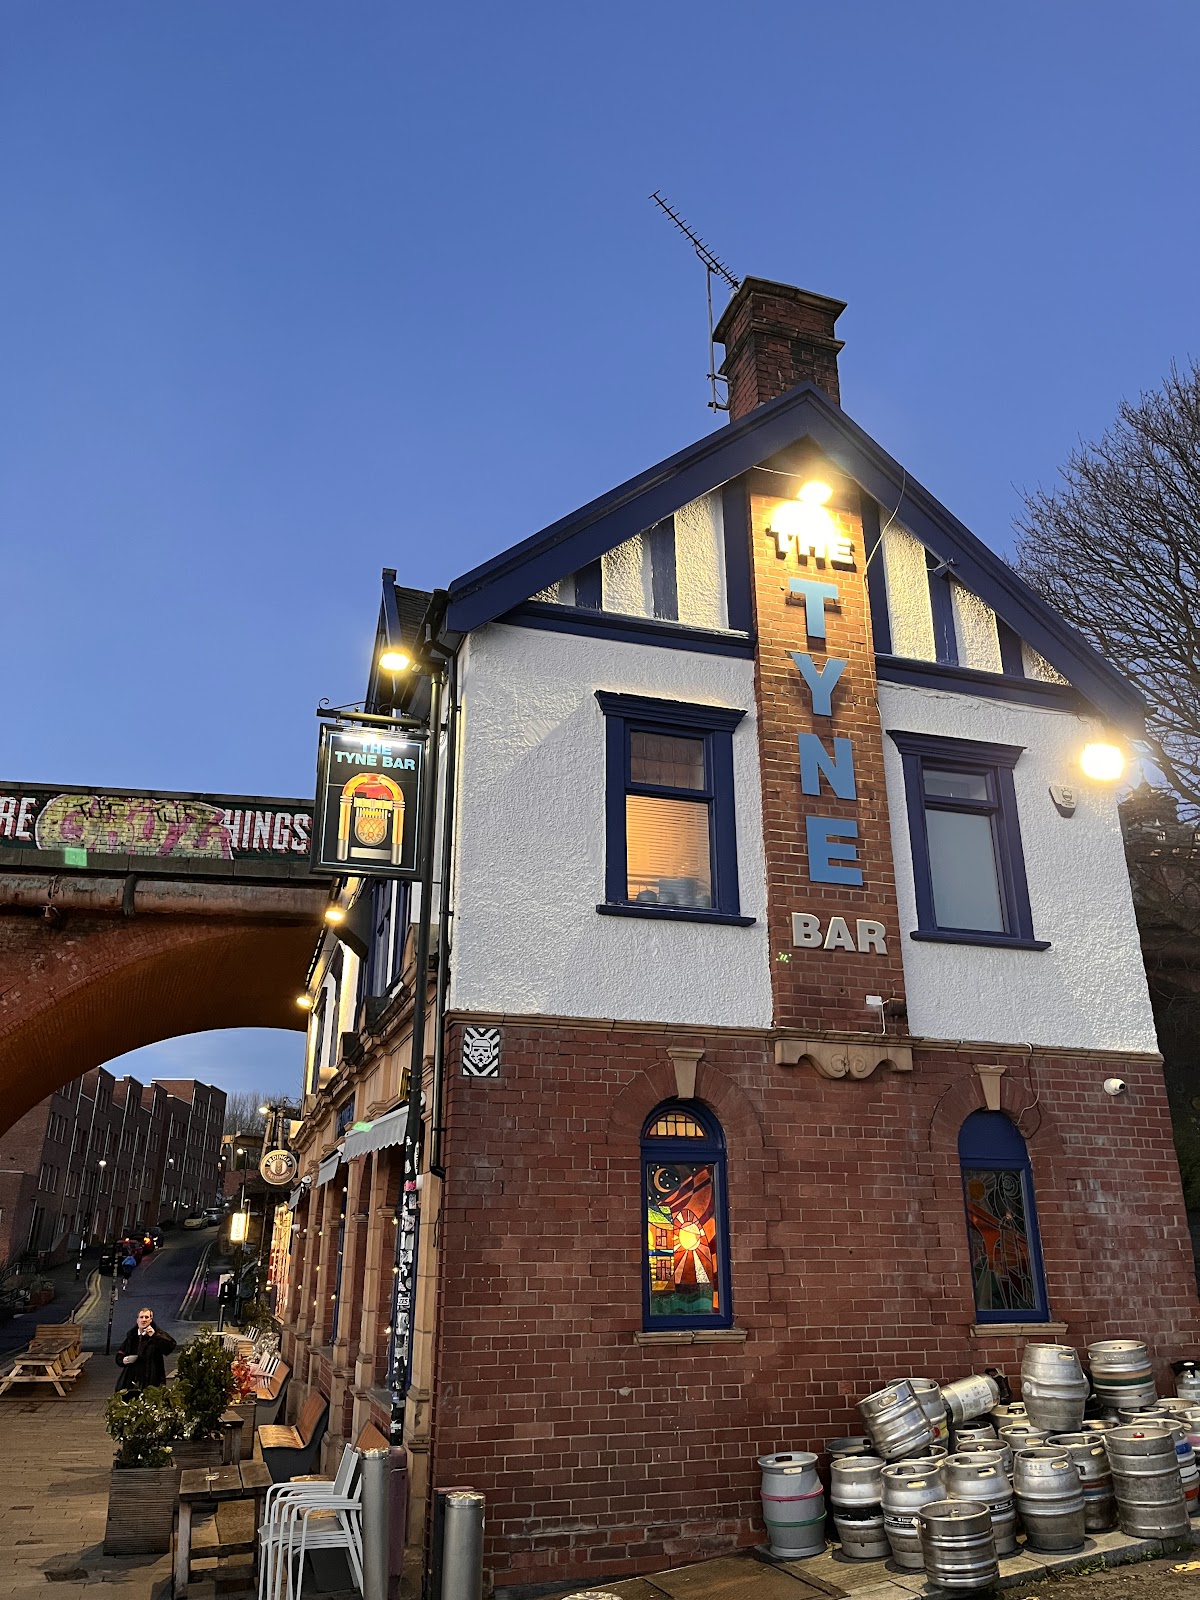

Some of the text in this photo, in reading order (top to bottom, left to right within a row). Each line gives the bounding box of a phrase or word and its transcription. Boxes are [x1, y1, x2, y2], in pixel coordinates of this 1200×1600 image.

[767, 521, 855, 568] THE
[361, 743, 392, 756] THE
[788, 577, 864, 887] TYNE
[334, 750, 416, 771] TYNE BAR
[791, 912, 888, 955] BAR
